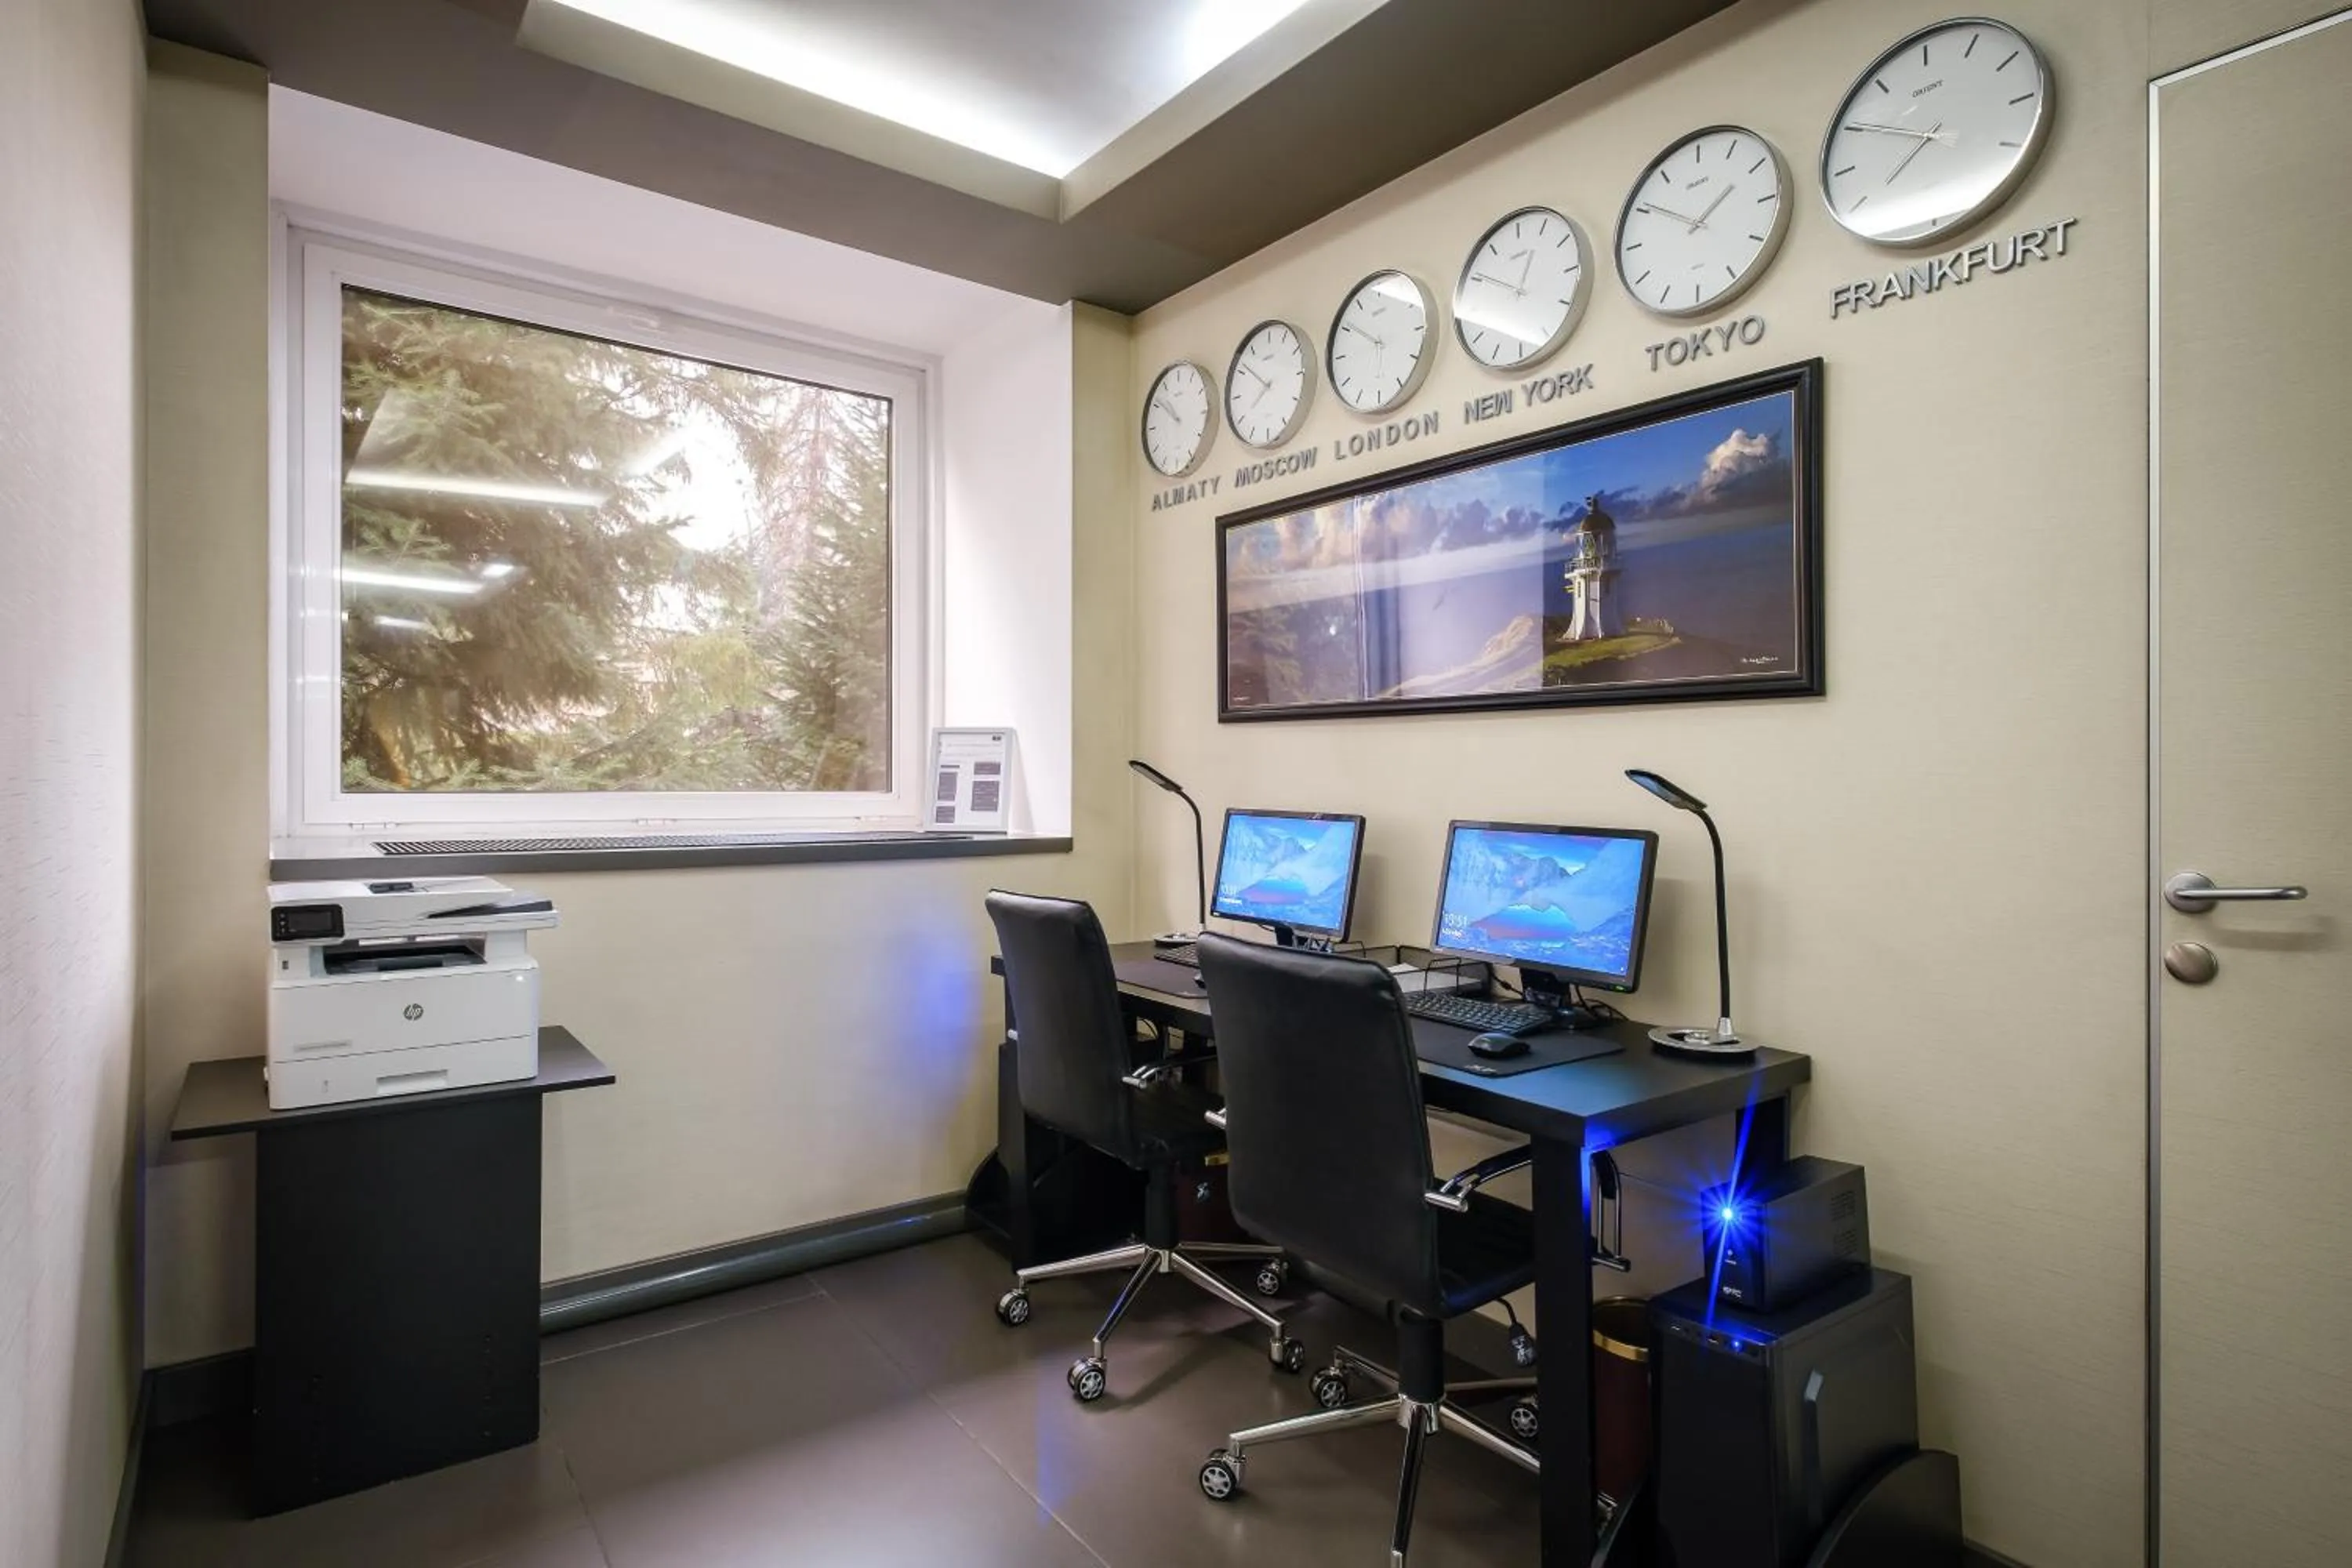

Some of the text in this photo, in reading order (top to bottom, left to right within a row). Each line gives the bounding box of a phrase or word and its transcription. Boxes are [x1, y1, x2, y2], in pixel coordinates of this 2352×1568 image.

[1831, 216, 2078, 319] FRANKFURT
[1645, 315, 1766, 372] TOKYO
[1463, 363, 1595, 425] NEW YORK
[1334, 411, 1440, 461] LONDON
[1152, 475, 1221, 512] ALMATY
[1234, 446, 1318, 488] MOSCOW
